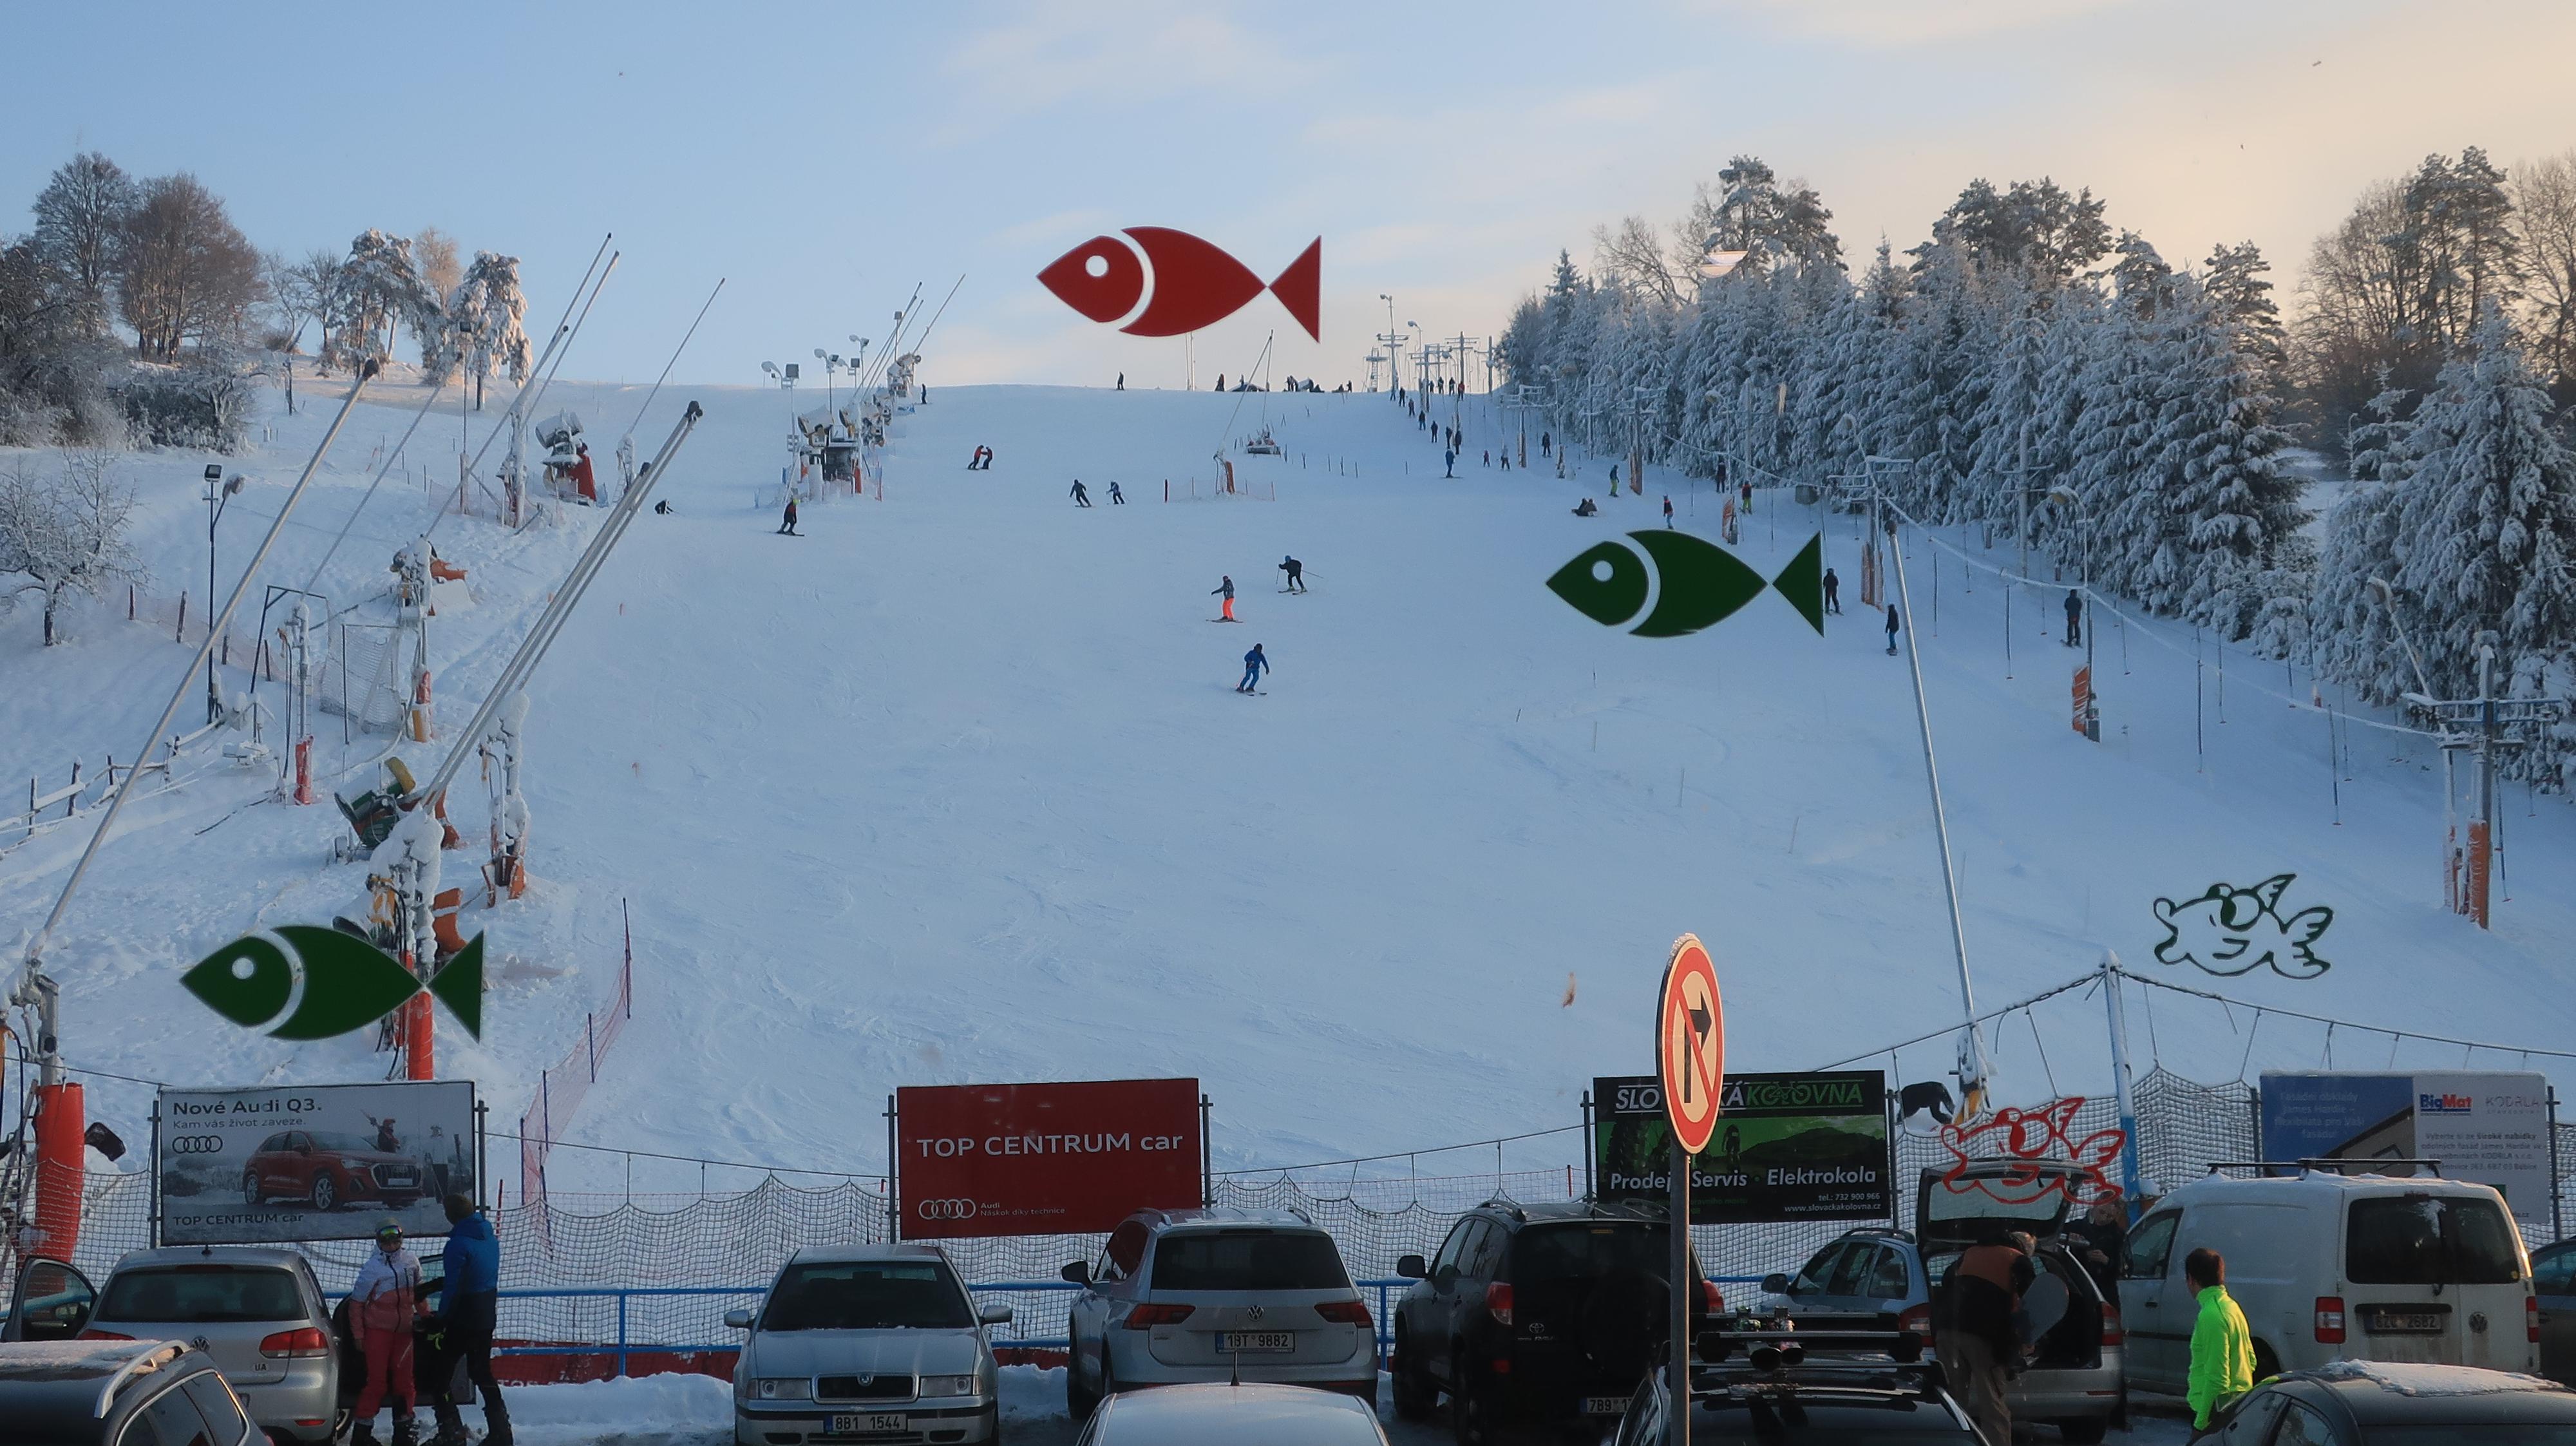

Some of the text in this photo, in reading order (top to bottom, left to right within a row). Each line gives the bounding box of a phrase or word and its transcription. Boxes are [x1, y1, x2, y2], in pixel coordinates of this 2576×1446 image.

[173, 1098, 322, 1116] Nové Audi Q3.
[2420, 1093, 2472, 1110] BigMat
[2485, 1096, 2540, 1107] KODRLA
[173, 1118, 307, 1129] Kam vás život zaveze.
[916, 1133, 1184, 1157] TOP CENTRUM car
[1611, 1166, 1876, 1192] Prodej Servis Elektrokola
[173, 1213, 304, 1226] TOP CENTRUM car
[1012, 1208, 1030, 1217] díky
[1226, 1333, 1289, 1347] 1BT 9882
[1589, 1398, 1612, 1411] 7B9
[835, 1415, 900, 1430] 8B1 1544
